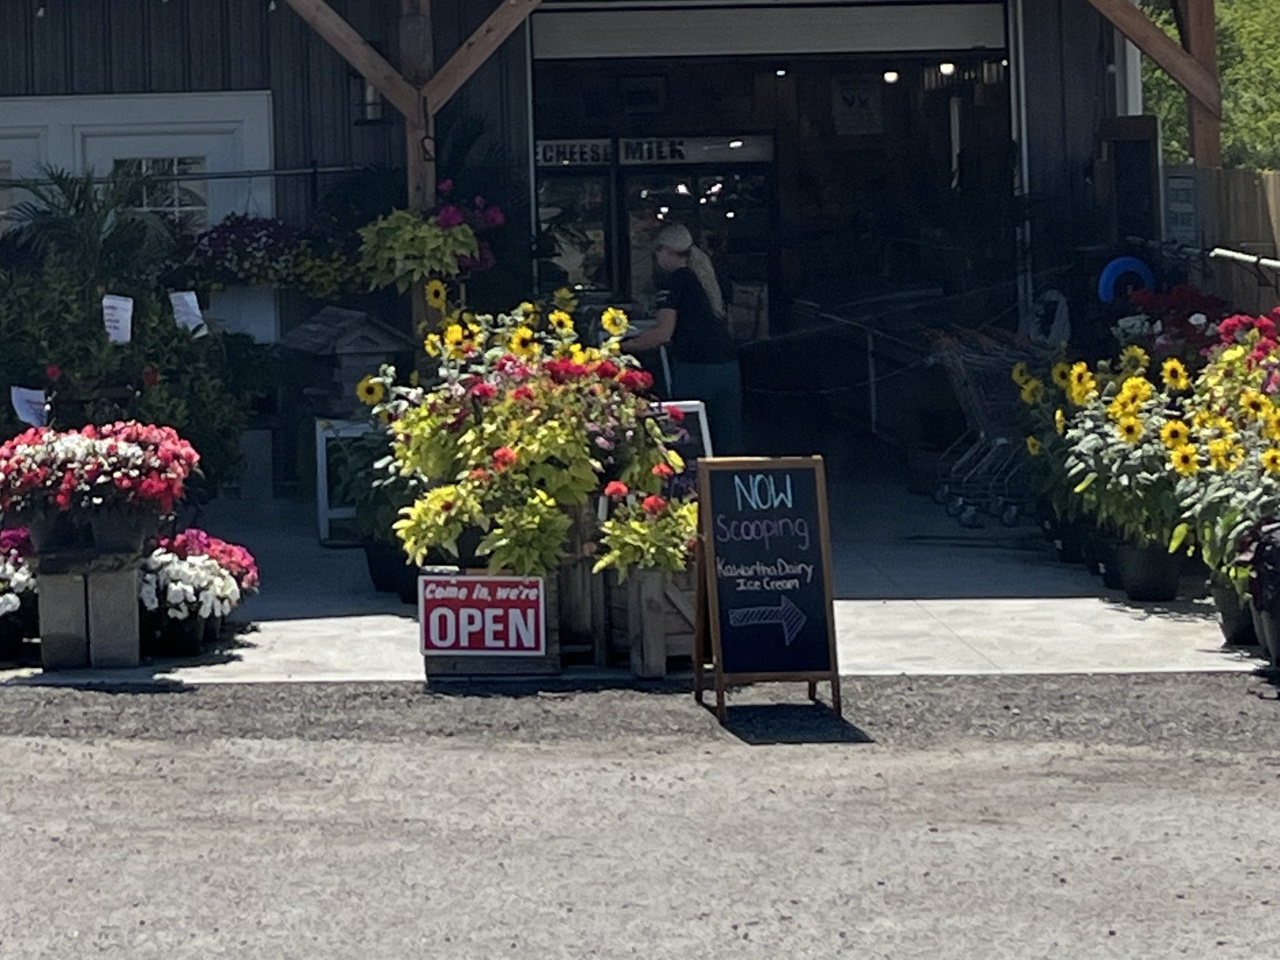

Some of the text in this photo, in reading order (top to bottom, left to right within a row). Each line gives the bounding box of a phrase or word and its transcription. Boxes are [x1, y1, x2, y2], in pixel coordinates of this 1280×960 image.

[733, 473, 793, 511] NOW
[716, 513, 810, 551] Scooping
[736, 576, 800, 591] Ice Cream
[777, 557, 814, 583] Dairy
[425, 582, 468, 600] Come
[496, 584, 539, 601] we're
[429, 606, 536, 648] OPEN
